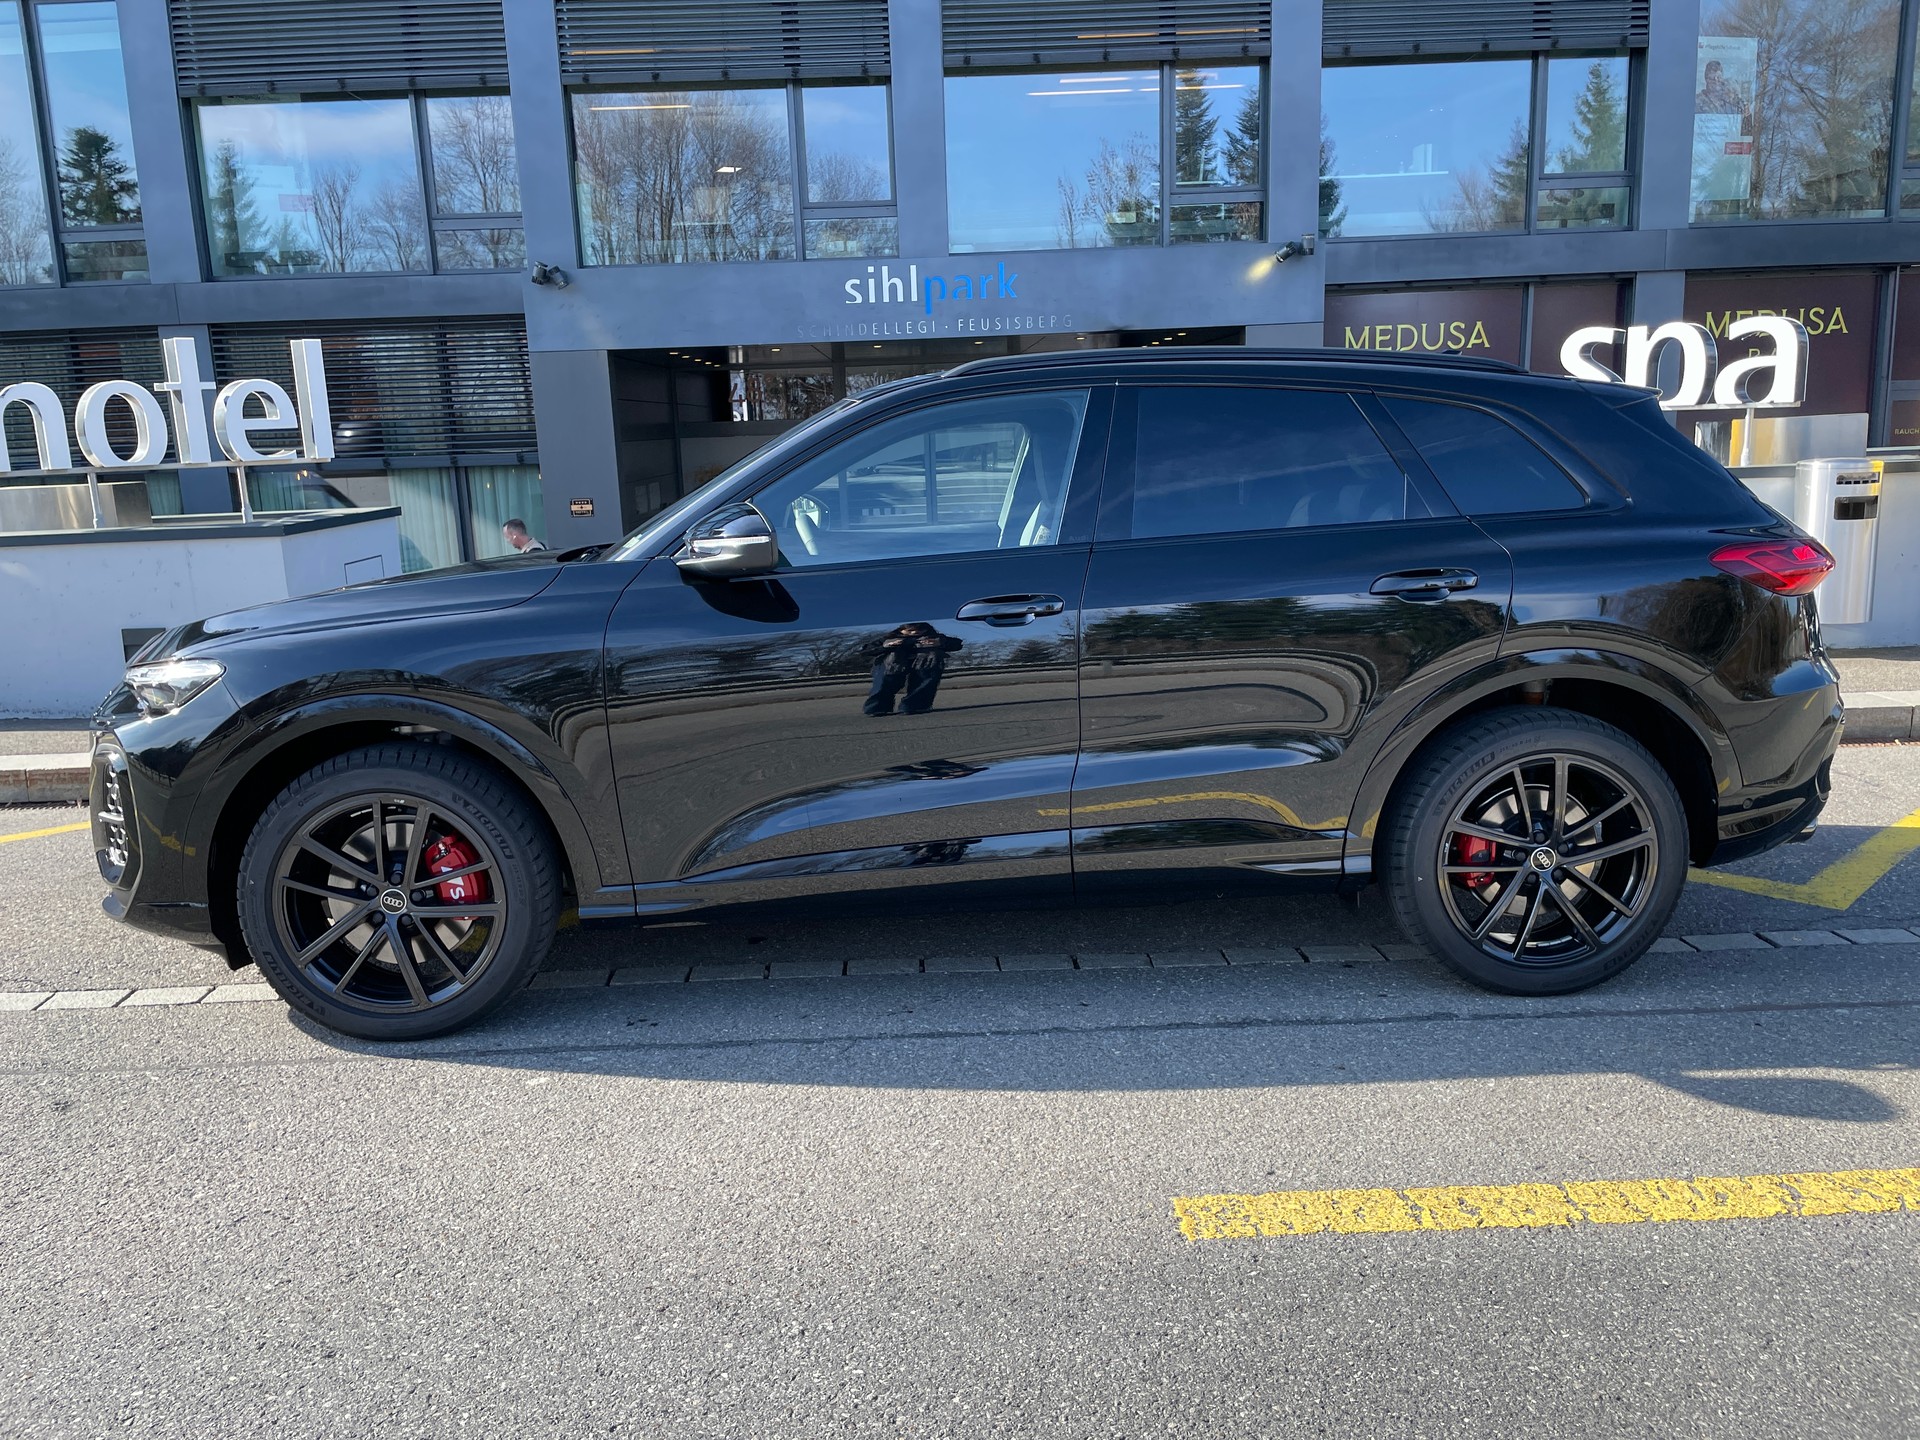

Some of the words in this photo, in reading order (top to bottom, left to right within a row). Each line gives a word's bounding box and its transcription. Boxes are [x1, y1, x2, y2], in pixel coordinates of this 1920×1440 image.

[844, 262, 1018, 315] sihlpark
[958, 314, 1072, 331] FEUSISBERG
[1344, 320, 1490, 352] MEDUSA
